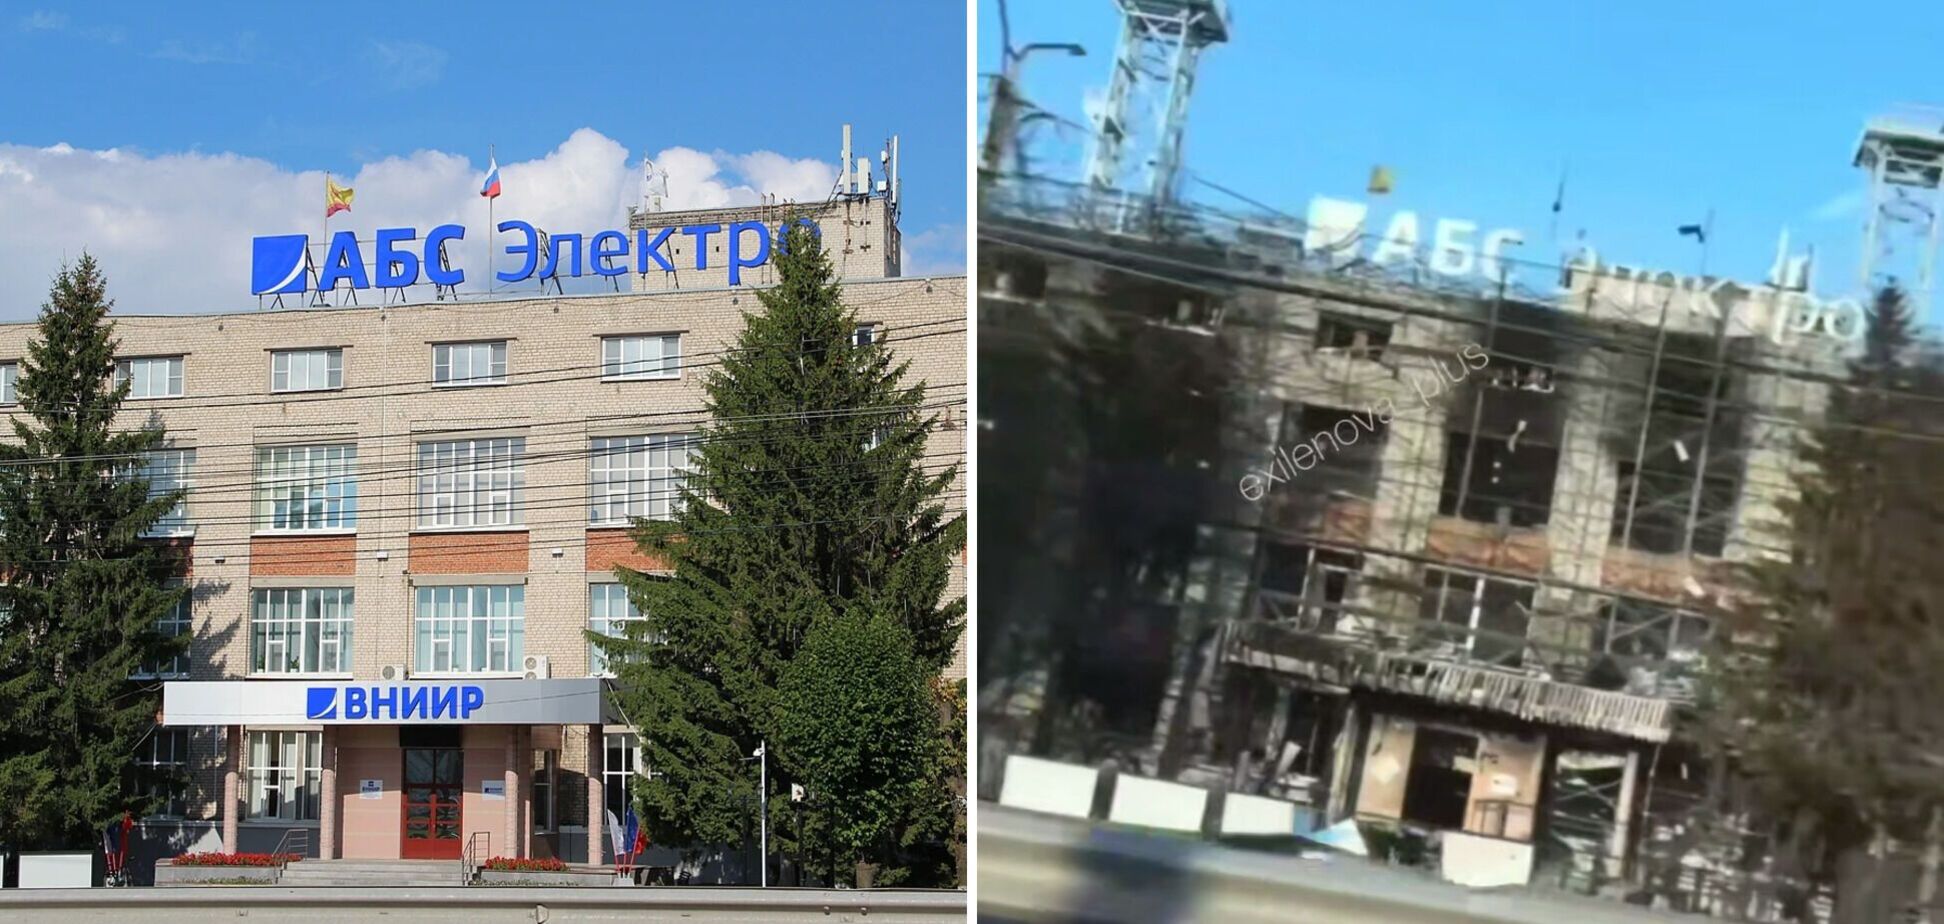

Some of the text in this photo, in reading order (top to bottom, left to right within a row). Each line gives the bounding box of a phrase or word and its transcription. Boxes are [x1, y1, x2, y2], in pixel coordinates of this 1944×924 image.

[319, 224, 466, 290] АБС
[1371, 209, 1524, 286] АБС
[345, 686, 484, 720] ВНИИР
